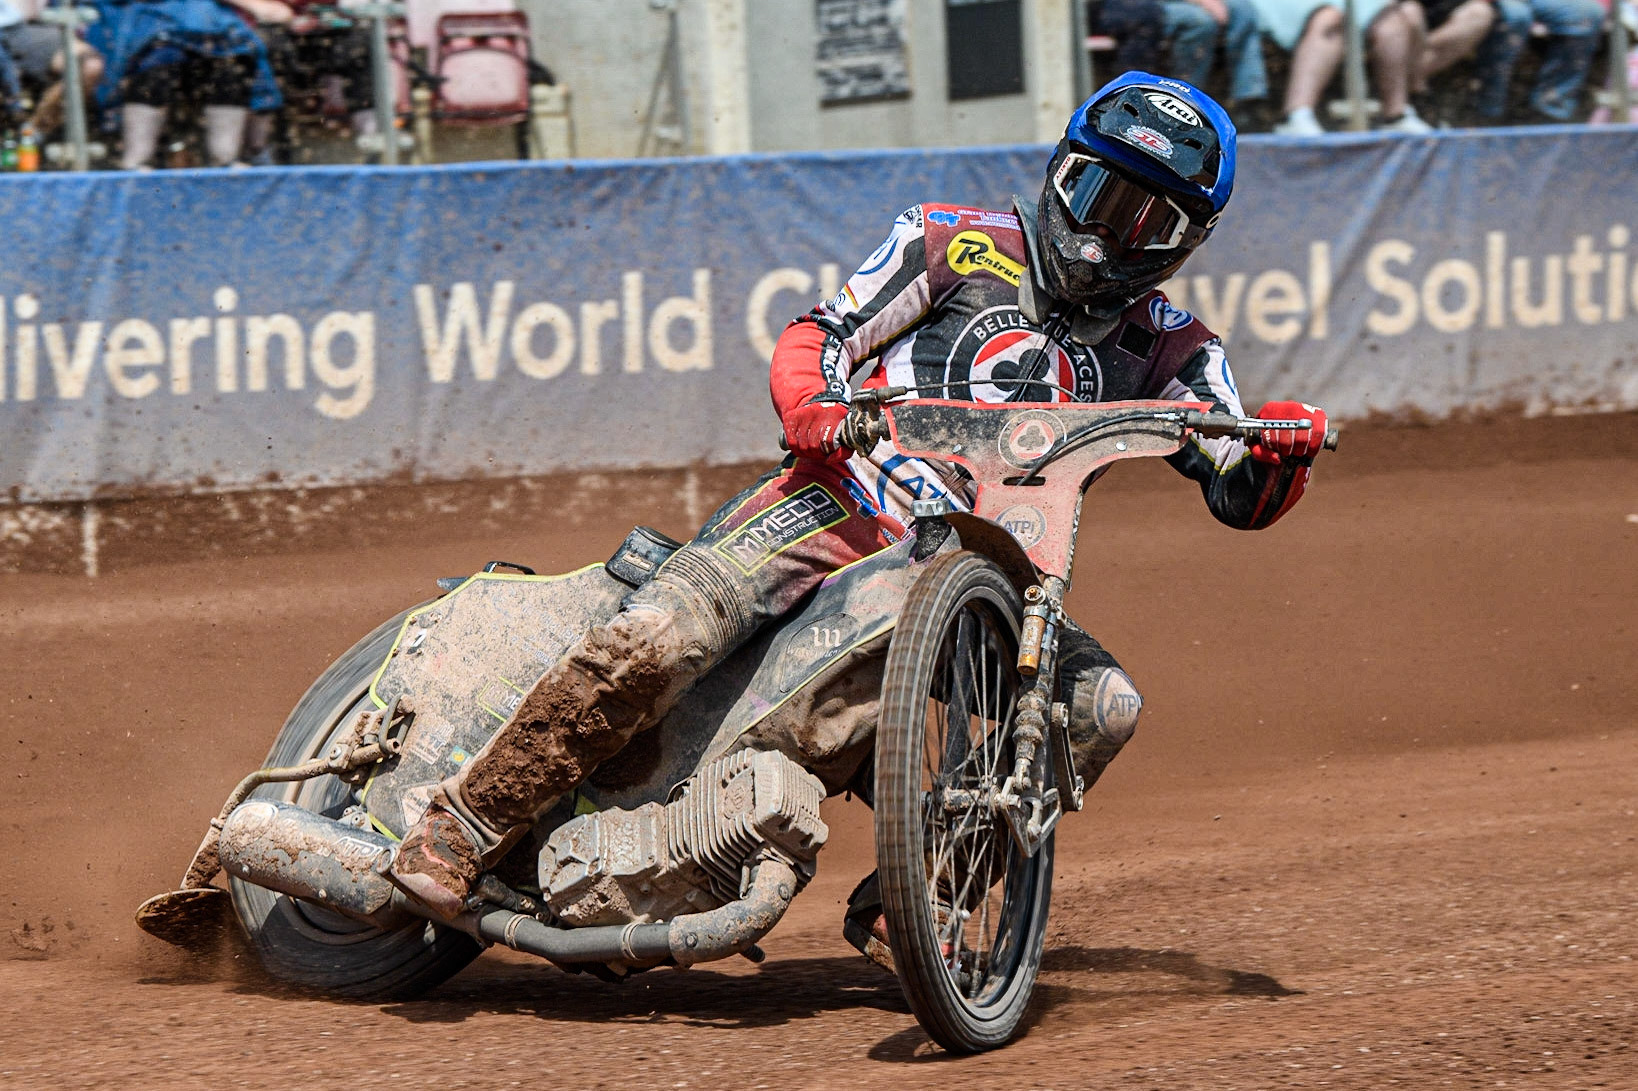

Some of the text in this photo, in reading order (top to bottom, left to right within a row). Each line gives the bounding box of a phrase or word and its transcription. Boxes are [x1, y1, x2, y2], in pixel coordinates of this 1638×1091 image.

[1154, 98, 1197, 123] Arai
[955, 238, 1021, 281] Rentruc
[0, 286, 375, 421] ivering
[413, 267, 714, 385] World
[1365, 223, 1638, 337] Soluti
[972, 313, 1029, 341] BELLE
[1073, 353, 1094, 403] ACES
[766, 505, 839, 547] CONSTRUCTION
